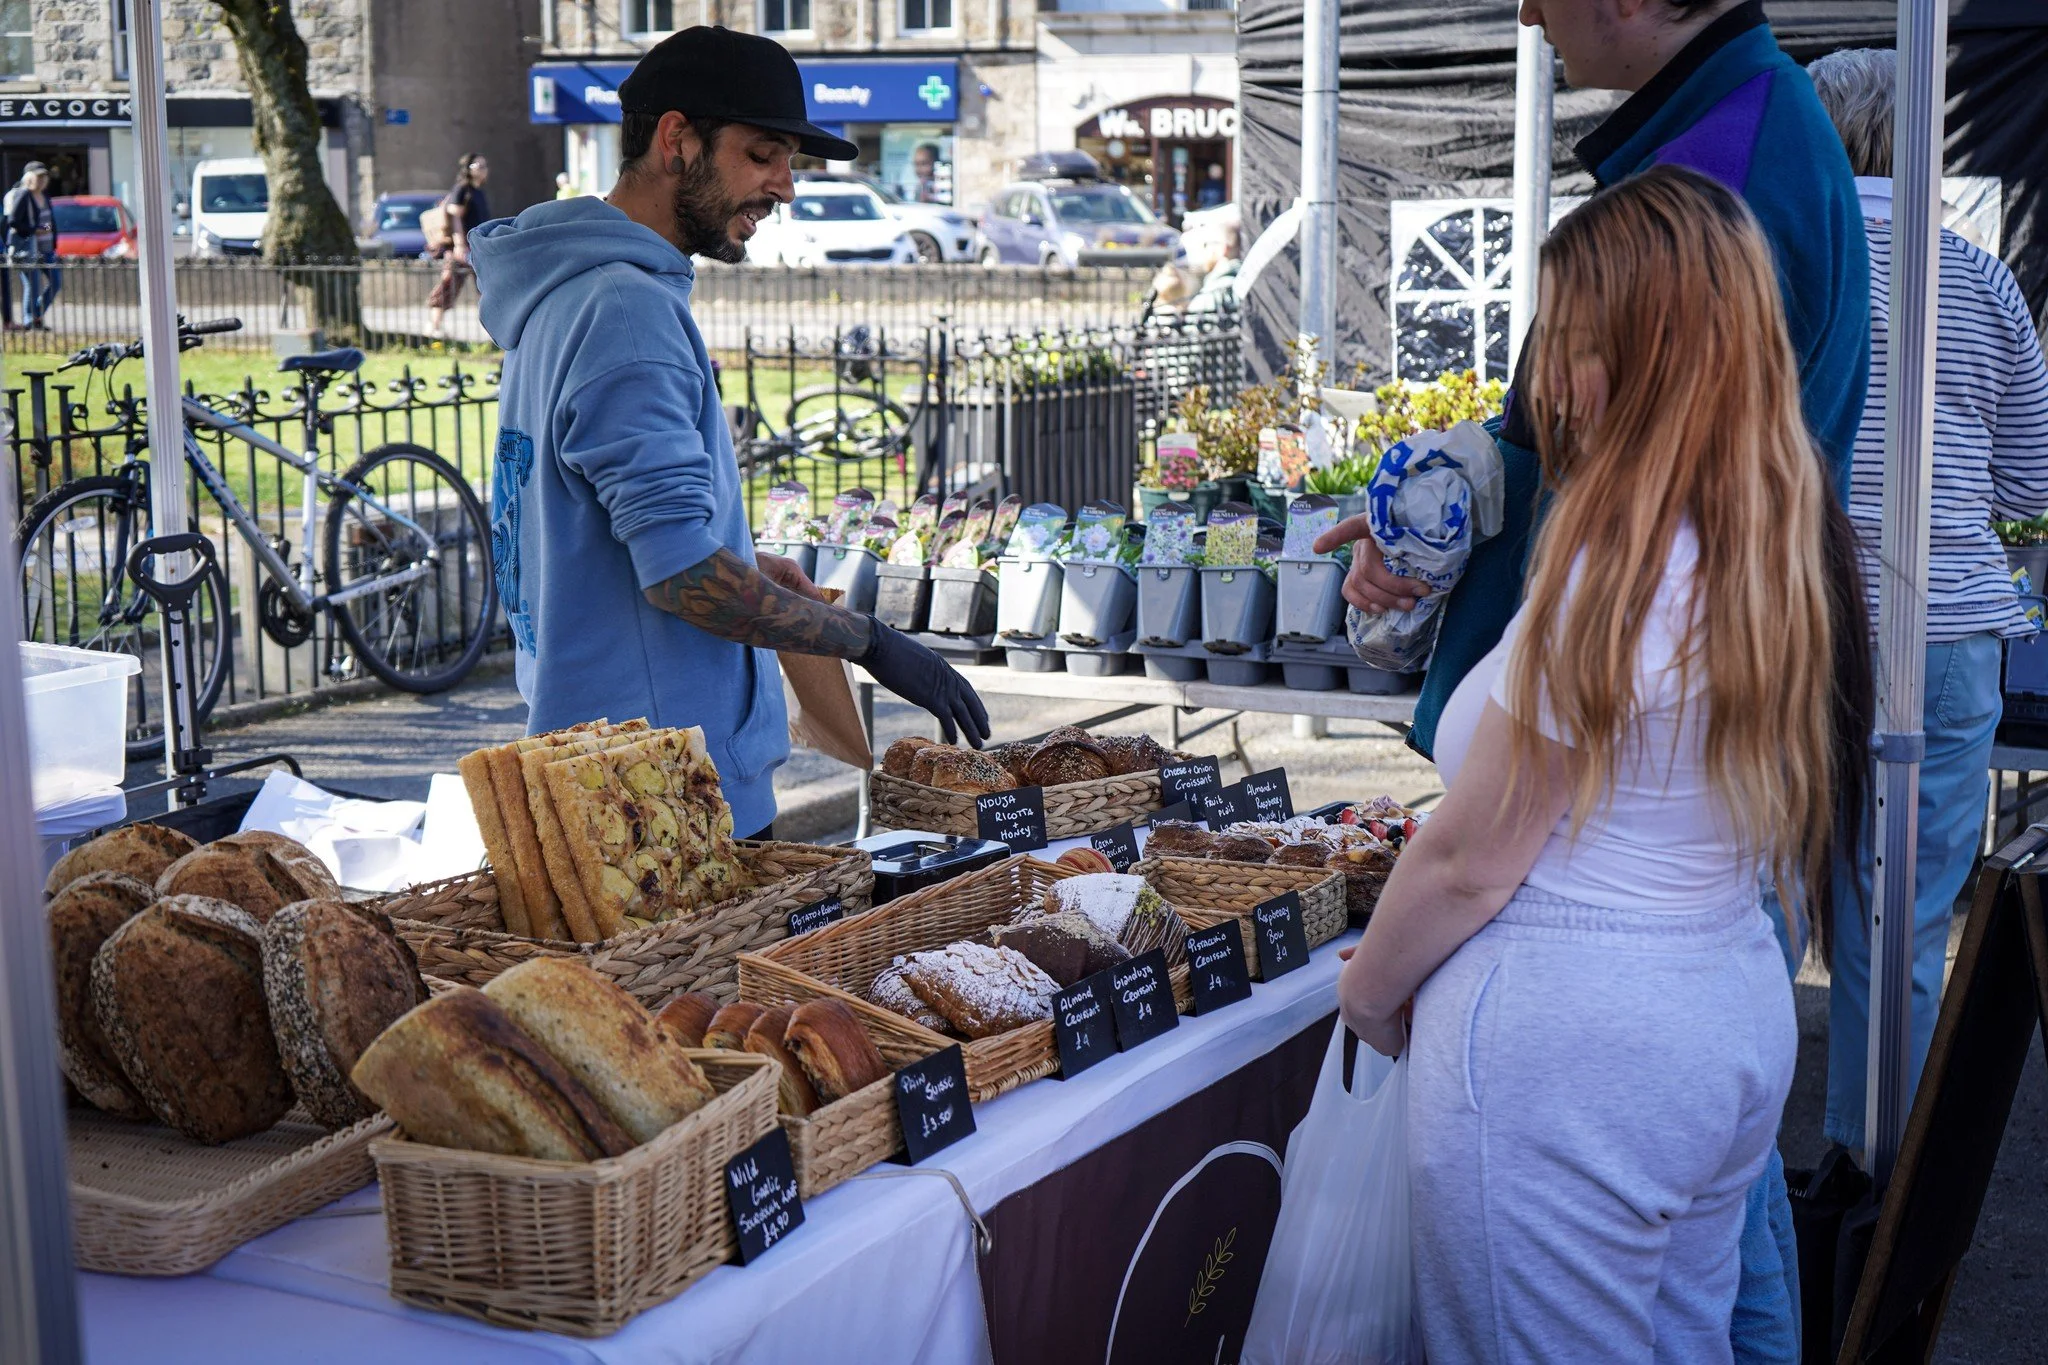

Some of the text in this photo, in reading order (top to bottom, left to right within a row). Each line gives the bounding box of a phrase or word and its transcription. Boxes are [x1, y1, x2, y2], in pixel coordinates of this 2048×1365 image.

[813, 83, 871, 107] Beauty
[0, 100, 132, 116] EACOCK
[1163, 767, 1187, 779] Cheese
[1193, 764, 1215, 775] Onion
[1175, 774, 1212, 790] Croissant
[1246, 782, 1272, 796] Almond
[995, 808, 1034, 822] RICOTTA
[1257, 906, 1290, 926] Raspberry
[1266, 928, 1284, 944] Bow
[1195, 946, 1231, 968] Croissant
[1276, 943, 1288, 963] £4
[1060, 985, 1093, 1012] Almond
[1122, 978, 1158, 1003] Croissant
[1065, 1001, 1100, 1027] Croissant
[1138, 1002, 1152, 1020] £4
[1075, 1031, 1091, 1051] £4
[922, 1109, 953, 1138] £3.50
[729, 1157, 759, 1188] Wild
[751, 1175, 781, 1207] Garlic
[762, 1210, 789, 1249] £4.90
